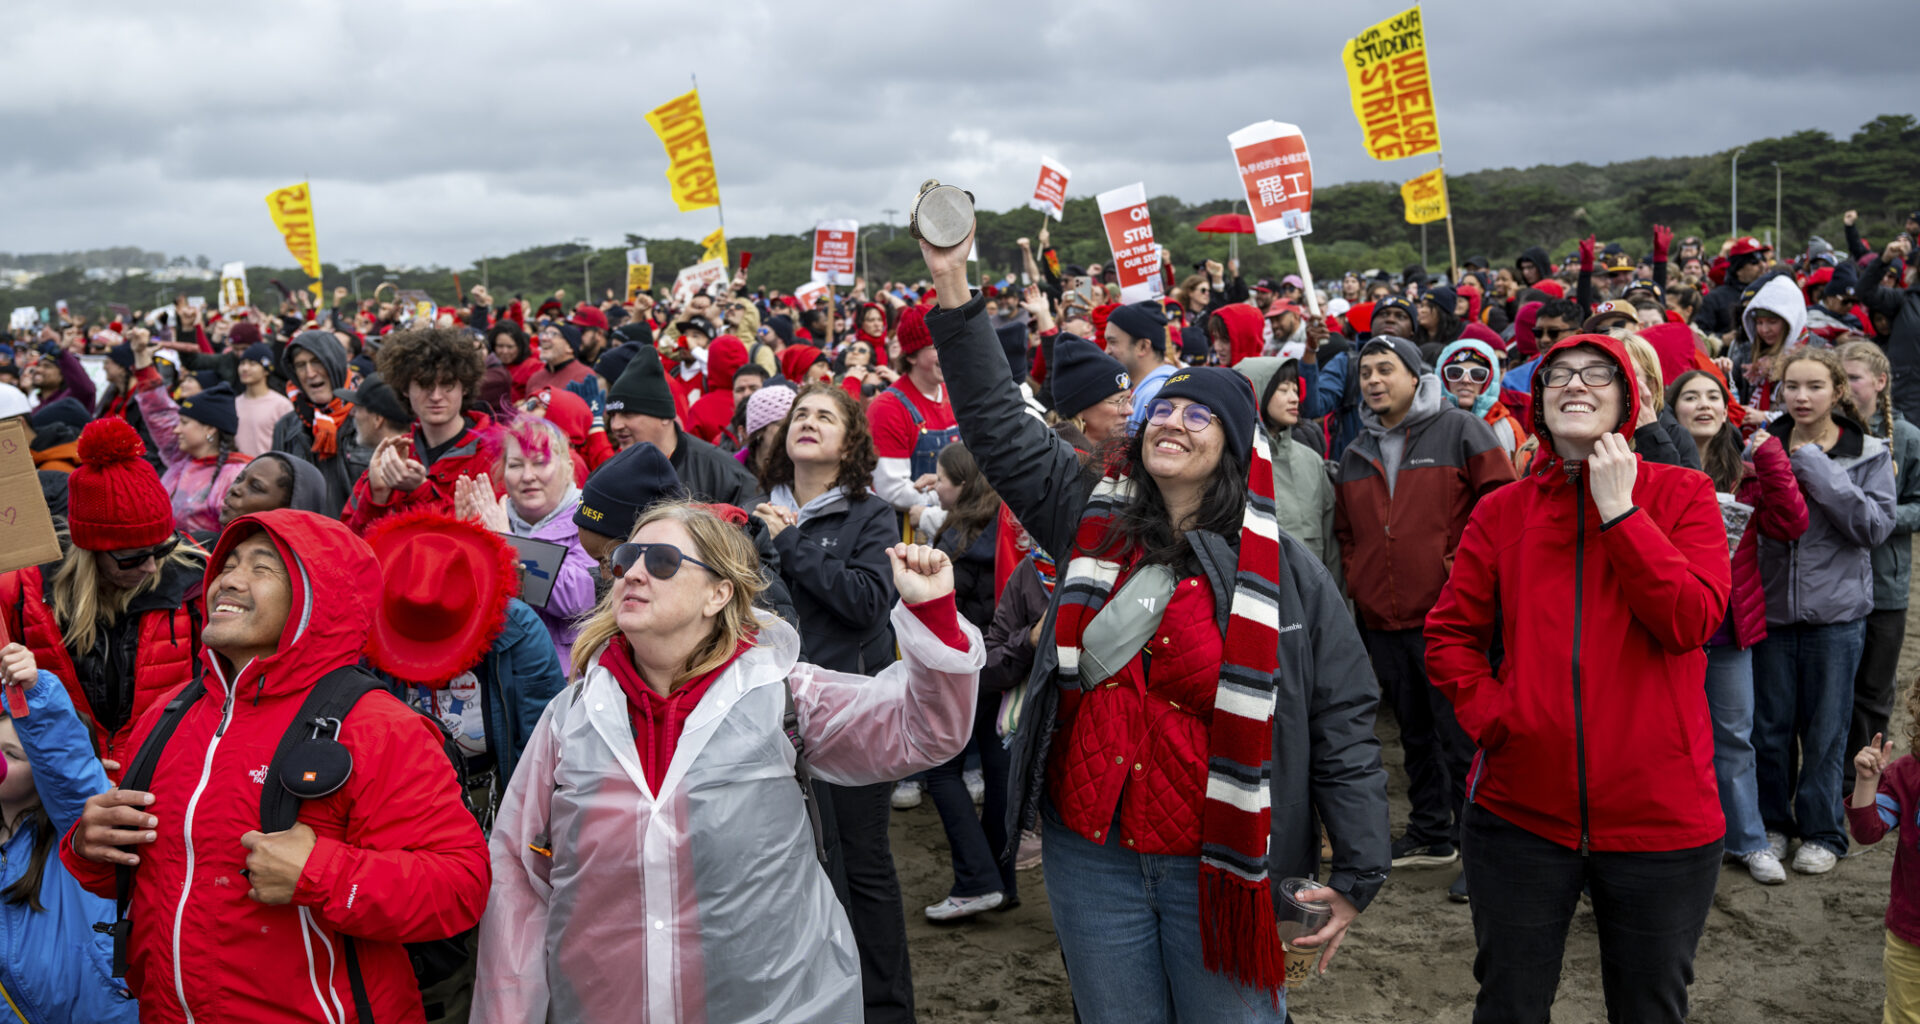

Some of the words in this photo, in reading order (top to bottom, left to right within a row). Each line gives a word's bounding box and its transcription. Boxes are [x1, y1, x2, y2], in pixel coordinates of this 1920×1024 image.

[1390, 10, 1420, 32] OUR
[1353, 29, 1422, 67] STUDENTS
[1361, 62, 1405, 160] STRIKE
[1391, 50, 1438, 156] HUELGA
[1256, 172, 1309, 208] 罷工
[1115, 249, 1132, 260] FOR
[1132, 244, 1147, 256] THE
[1124, 257, 1142, 269] OUR
[582, 505, 604, 522] UESF
